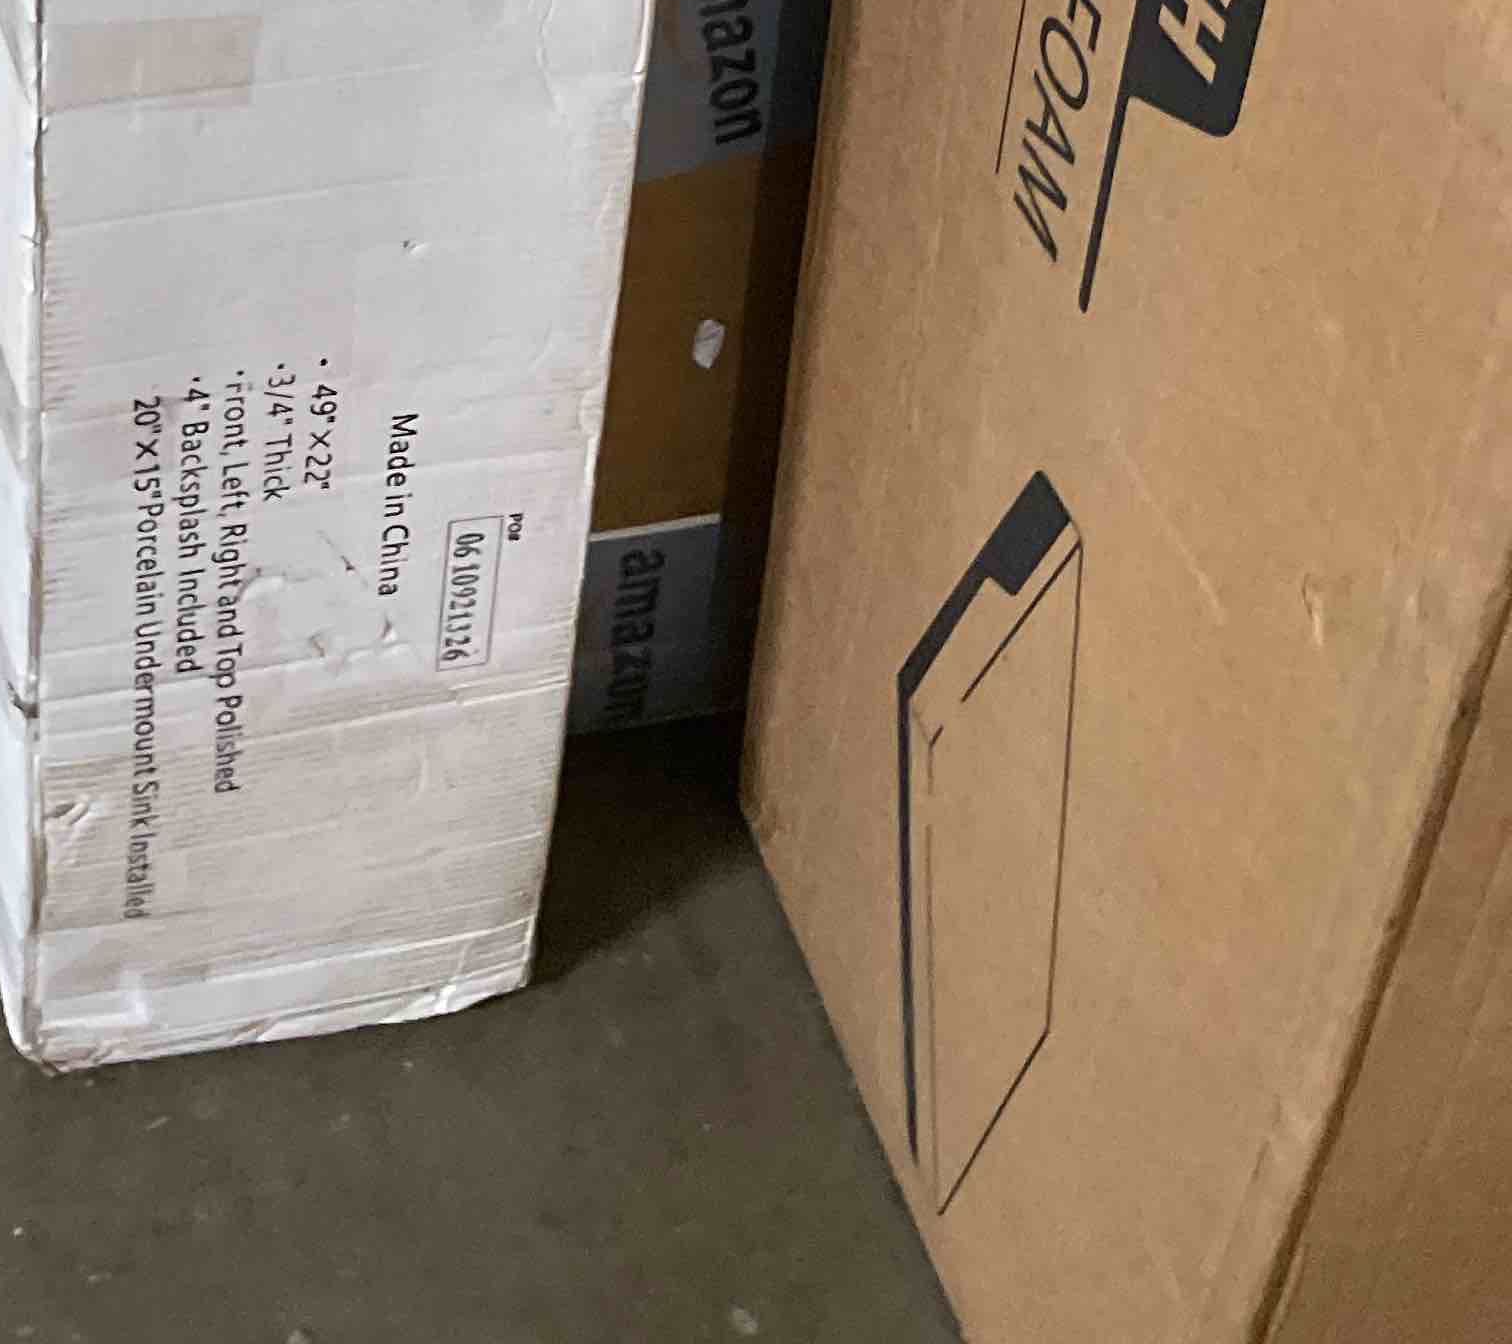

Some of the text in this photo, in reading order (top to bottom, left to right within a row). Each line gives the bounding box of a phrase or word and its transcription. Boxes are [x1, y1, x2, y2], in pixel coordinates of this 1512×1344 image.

[172, 420, 210, 559] Backsplash
[215, 462, 248, 518] Left,
[262, 433, 293, 503] Thick
[377, 413, 419, 596] Made in China
[133, 504, 164, 617] Porcelain
[210, 524, 247, 589] Right
[174, 569, 204, 674] Included
[216, 594, 244, 638] and
[605, 547, 667, 716] amazon
[131, 622, 160, 777] Undermount
[207, 642, 242, 690] Top
[212, 695, 241, 794] Polished
[129, 781, 158, 828] Sink
[122, 833, 154, 920] Installed
